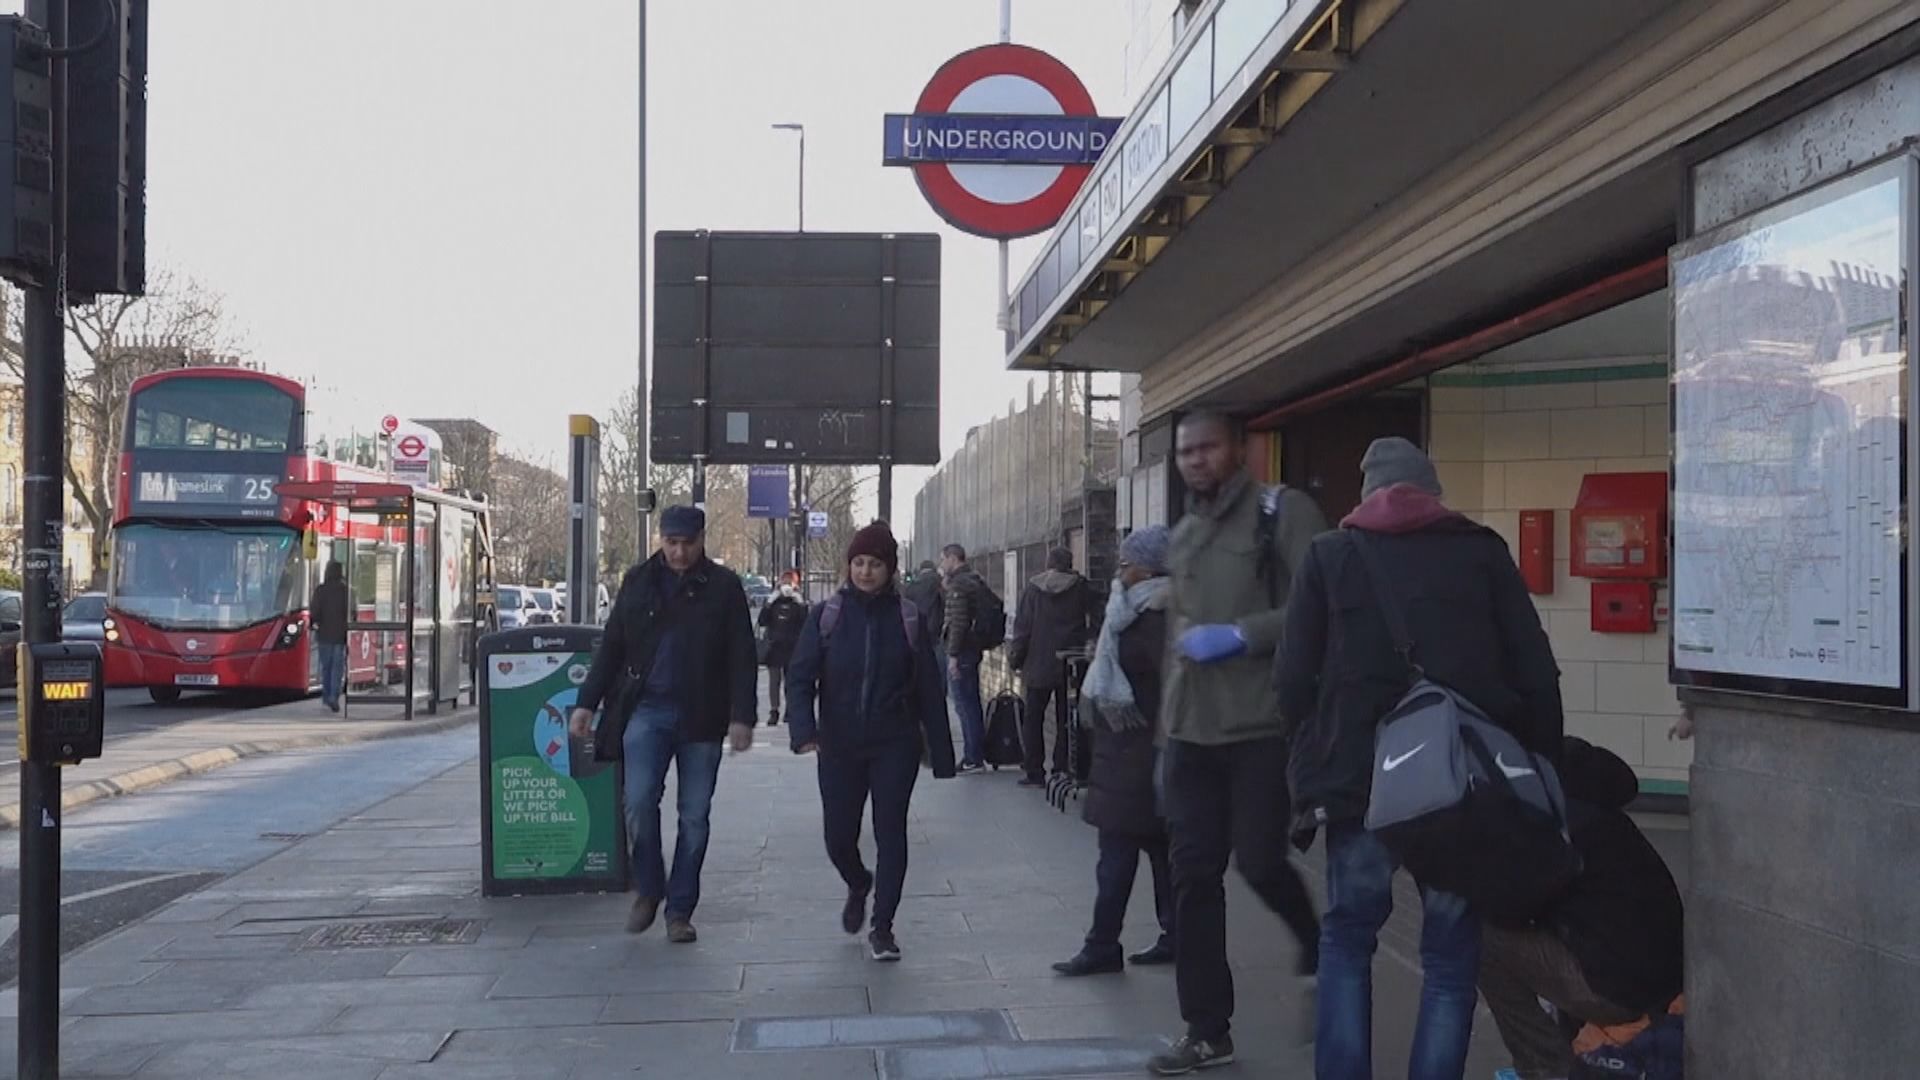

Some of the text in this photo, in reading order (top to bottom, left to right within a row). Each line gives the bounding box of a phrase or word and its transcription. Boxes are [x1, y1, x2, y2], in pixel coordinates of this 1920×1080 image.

[904, 128, 1107, 151] UNDERGROUND
[245, 478, 273, 500] 25
[43, 683, 88, 700] WAIT
[502, 767, 532, 777] PICK
[503, 778, 558, 789] UP YOUR
[503, 788, 567, 801] LITTER OR
[503, 801, 557, 812] WE PICK
[503, 812, 577, 823] UP THE BILL
